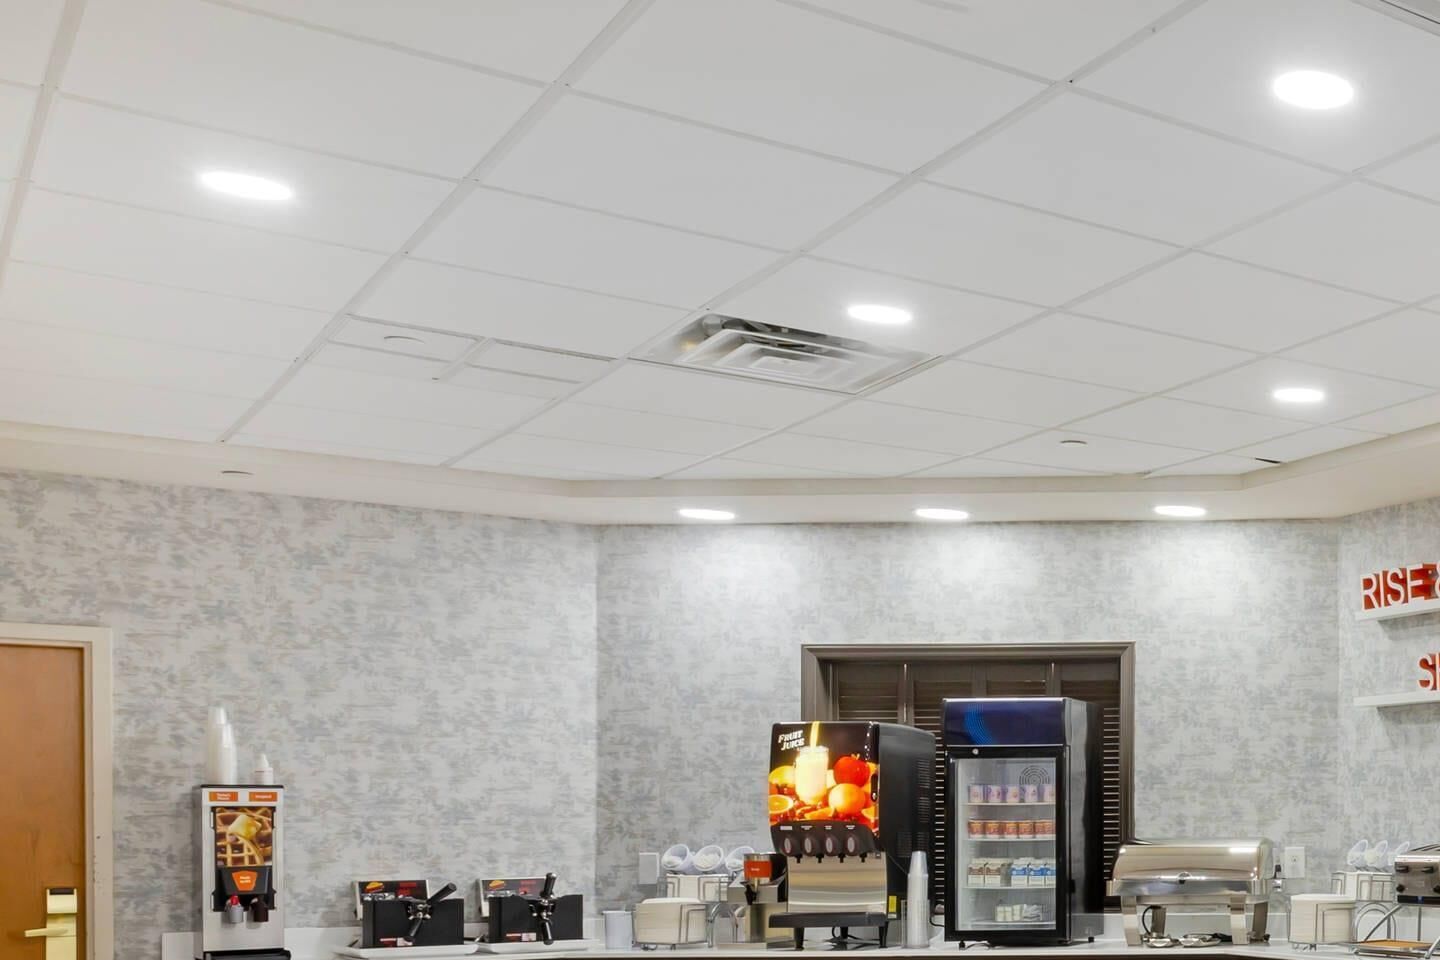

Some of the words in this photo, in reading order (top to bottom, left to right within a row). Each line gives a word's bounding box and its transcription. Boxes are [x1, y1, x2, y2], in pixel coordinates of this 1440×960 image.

[1360, 563, 1426, 611] RISE
[778, 729, 803, 744] FRUIT
[780, 737, 805, 751] JUICE
